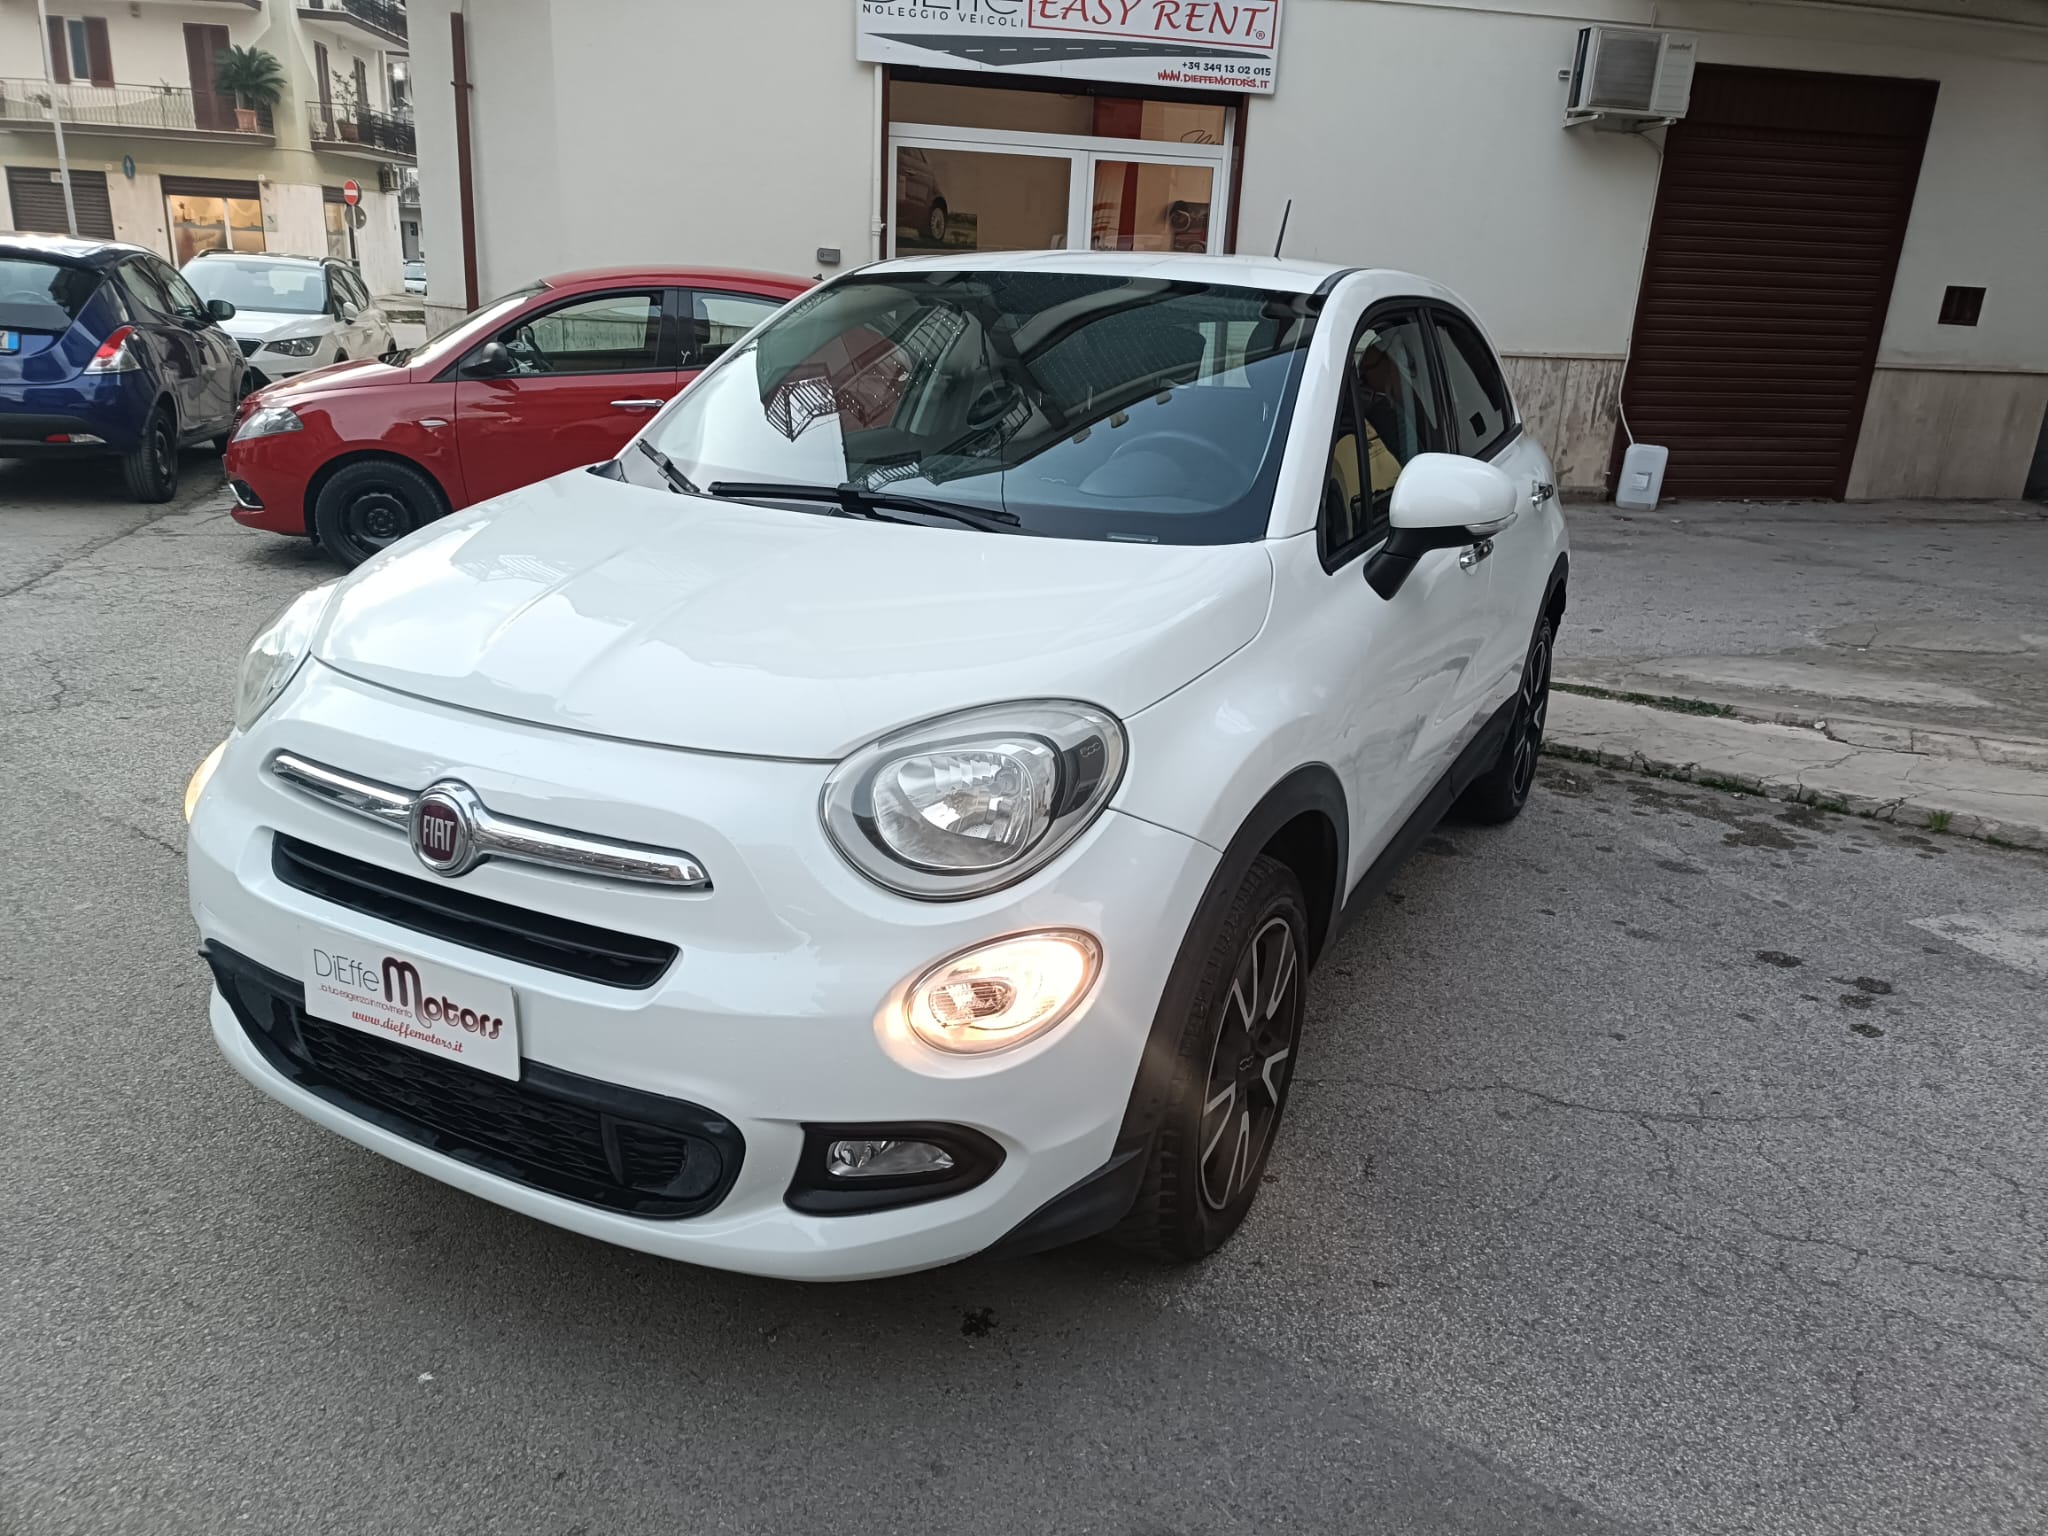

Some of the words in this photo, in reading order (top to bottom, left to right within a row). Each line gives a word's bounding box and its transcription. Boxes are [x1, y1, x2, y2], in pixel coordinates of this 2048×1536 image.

[862, 4, 949, 21] NOLEGGIO
[958, 13, 1024, 28] VEICOLI
[1039, 0, 1142, 25] EASY
[1153, 1, 1270, 37] RENT
[1182, 62, 1200, 70] +39
[1203, 63, 1221, 72] 349
[1225, 64, 1235, 73] 13
[1238, 66, 1250, 75] 02
[1254, 67, 1271, 76] 015
[423, 815, 455, 852] FIAT
[313, 949, 379, 992] DiEffe
[352, 1010, 463, 1053] www.dieffemotors.it
